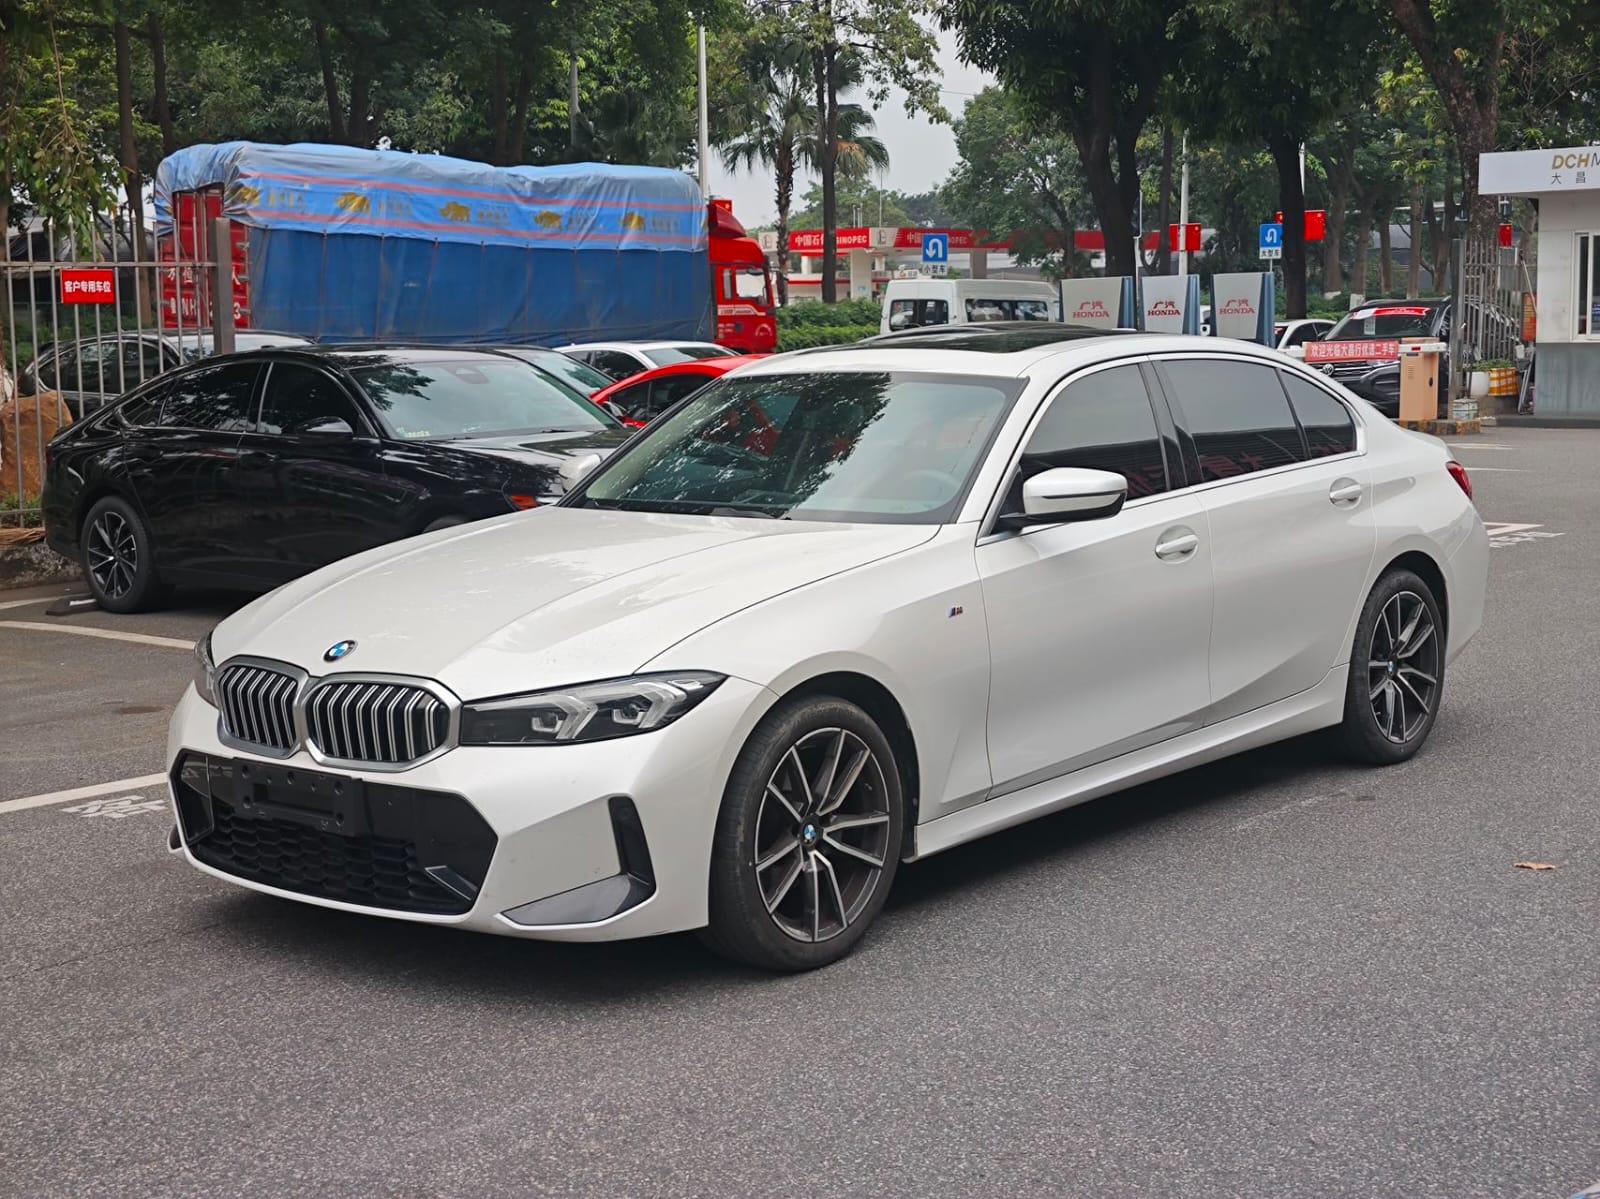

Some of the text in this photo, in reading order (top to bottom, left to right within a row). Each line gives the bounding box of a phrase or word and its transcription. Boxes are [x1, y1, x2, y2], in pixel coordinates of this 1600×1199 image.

[64, 280, 112, 293] 客户专用车位
[1153, 300, 1176, 309] 广汽
[1072, 310, 1110, 319] HONDA
[1147, 309, 1182, 317] HONDA
[1219, 307, 1255, 316] HONDA
